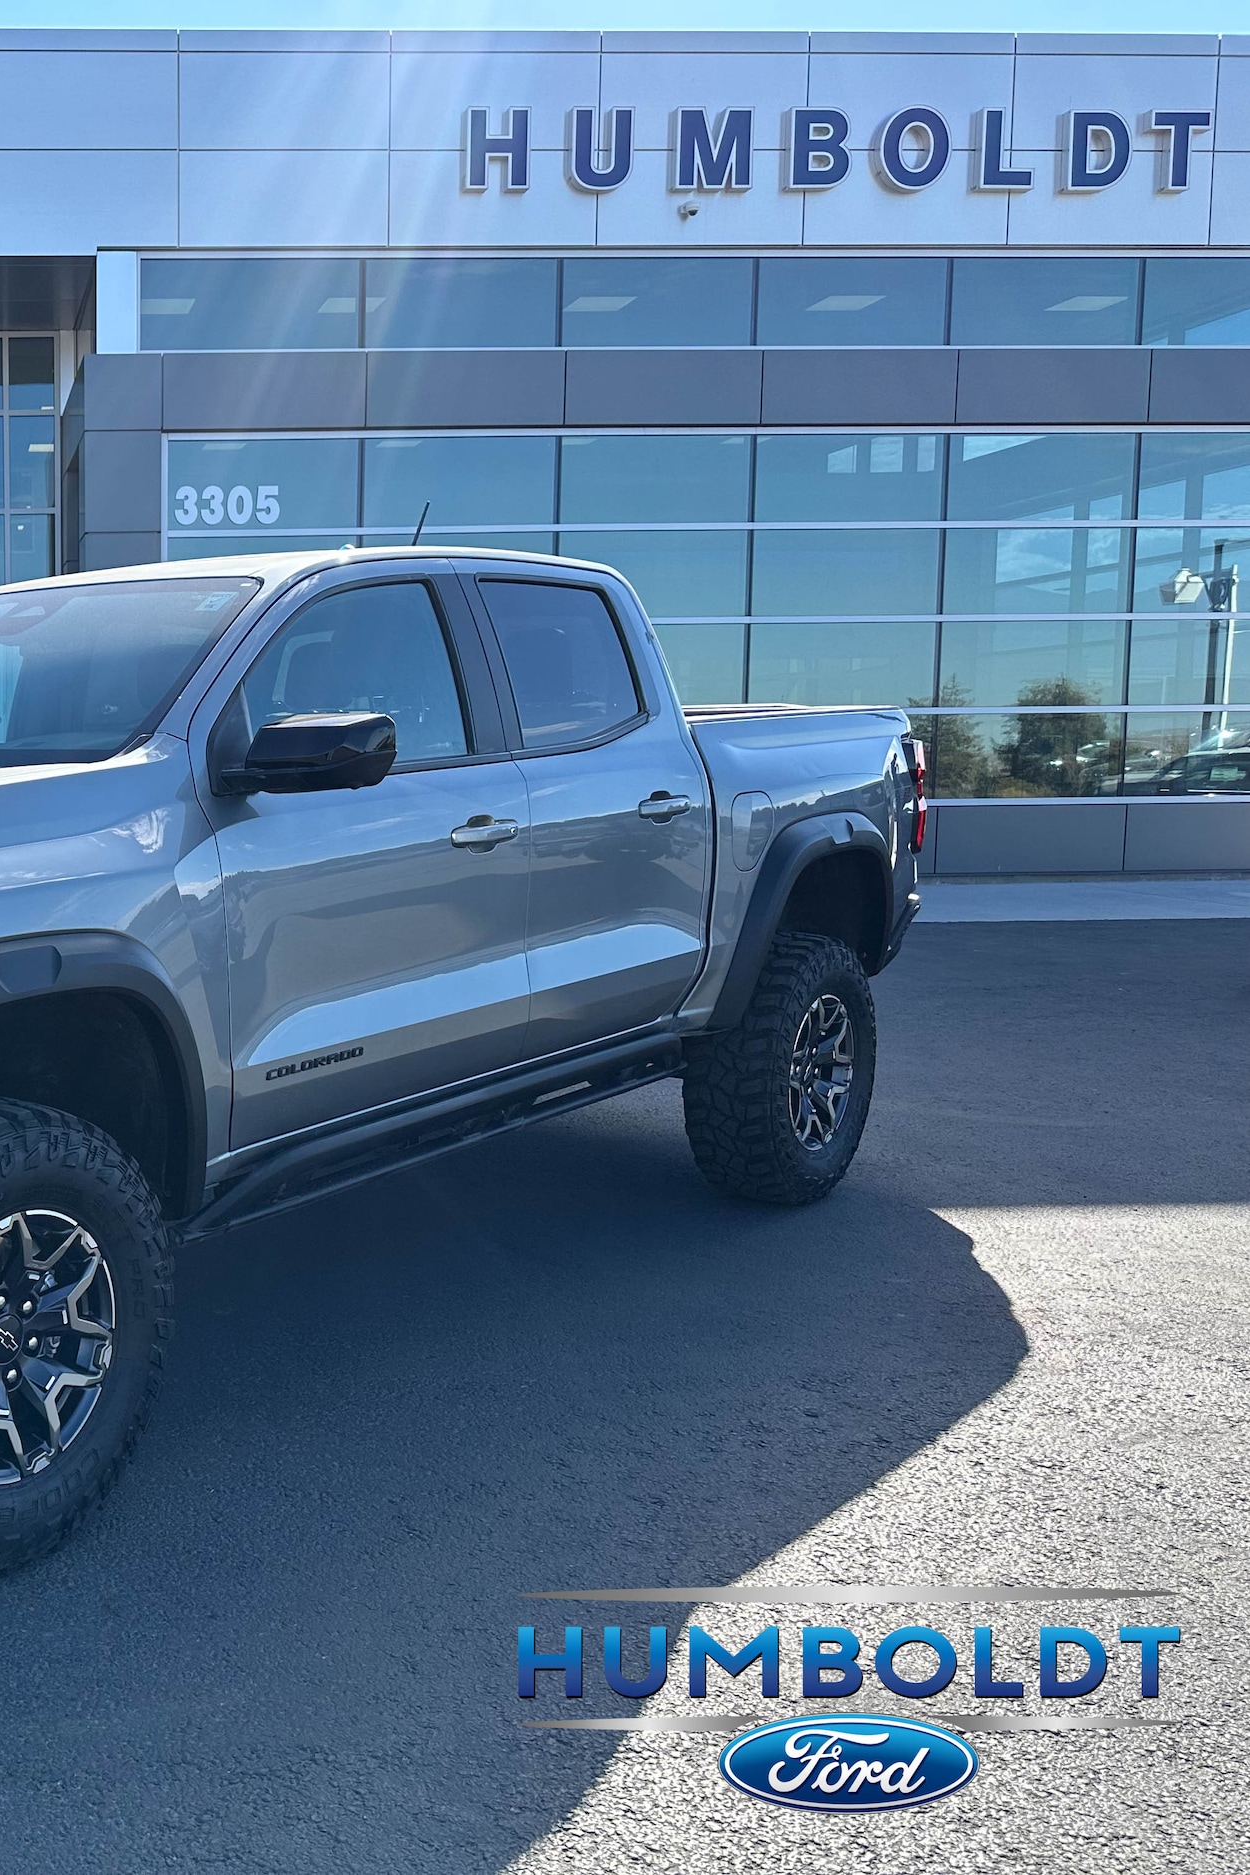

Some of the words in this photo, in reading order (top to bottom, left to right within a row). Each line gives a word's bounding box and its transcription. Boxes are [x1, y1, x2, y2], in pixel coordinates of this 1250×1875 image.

[462, 104, 1214, 194] HUMBOLDT
[174, 485, 281, 525] 3305
[265, 1046, 364, 1081] COLORADO
